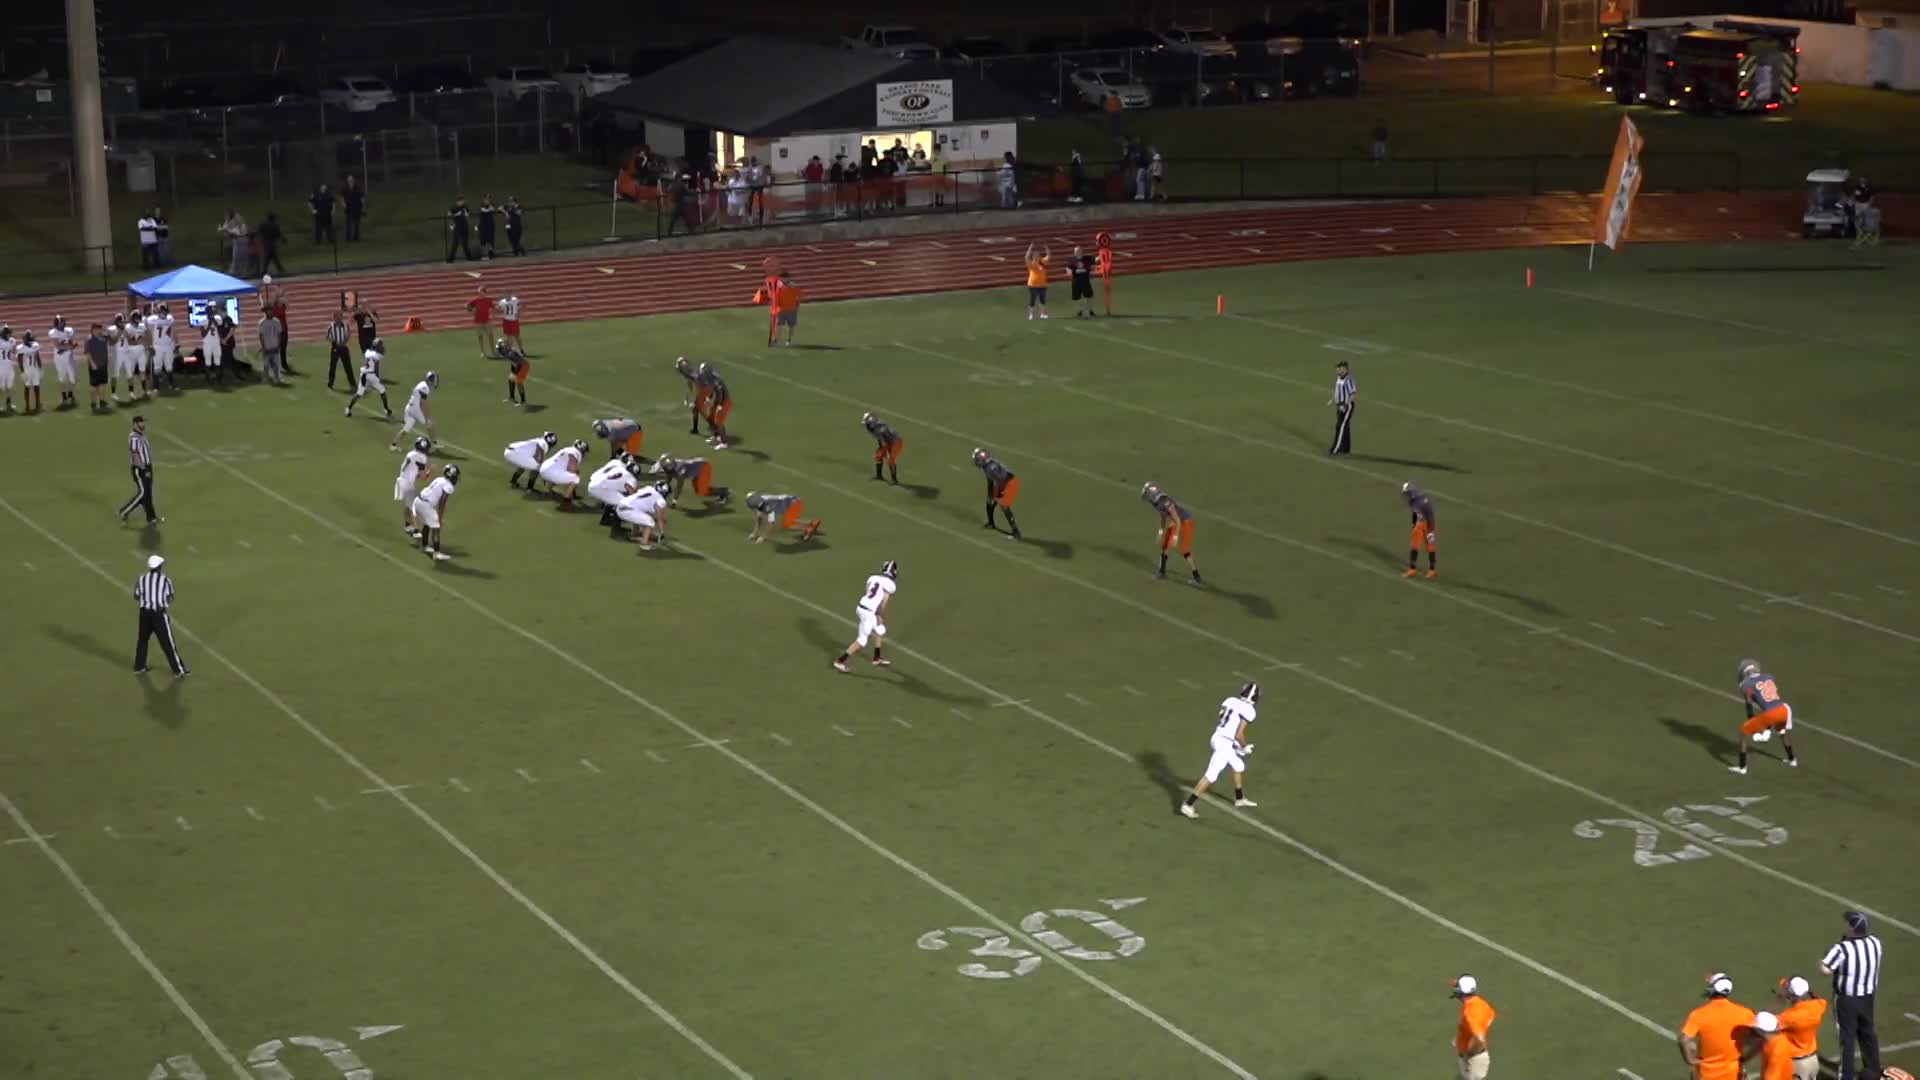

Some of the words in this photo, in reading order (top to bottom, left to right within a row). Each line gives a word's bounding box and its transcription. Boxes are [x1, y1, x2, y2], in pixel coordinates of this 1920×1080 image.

[907, 96, 927, 108] OP
[1572, 804, 1789, 867] 20
[916, 909, 1146, 979] 30
[148, 1035, 374, 1080] 0
